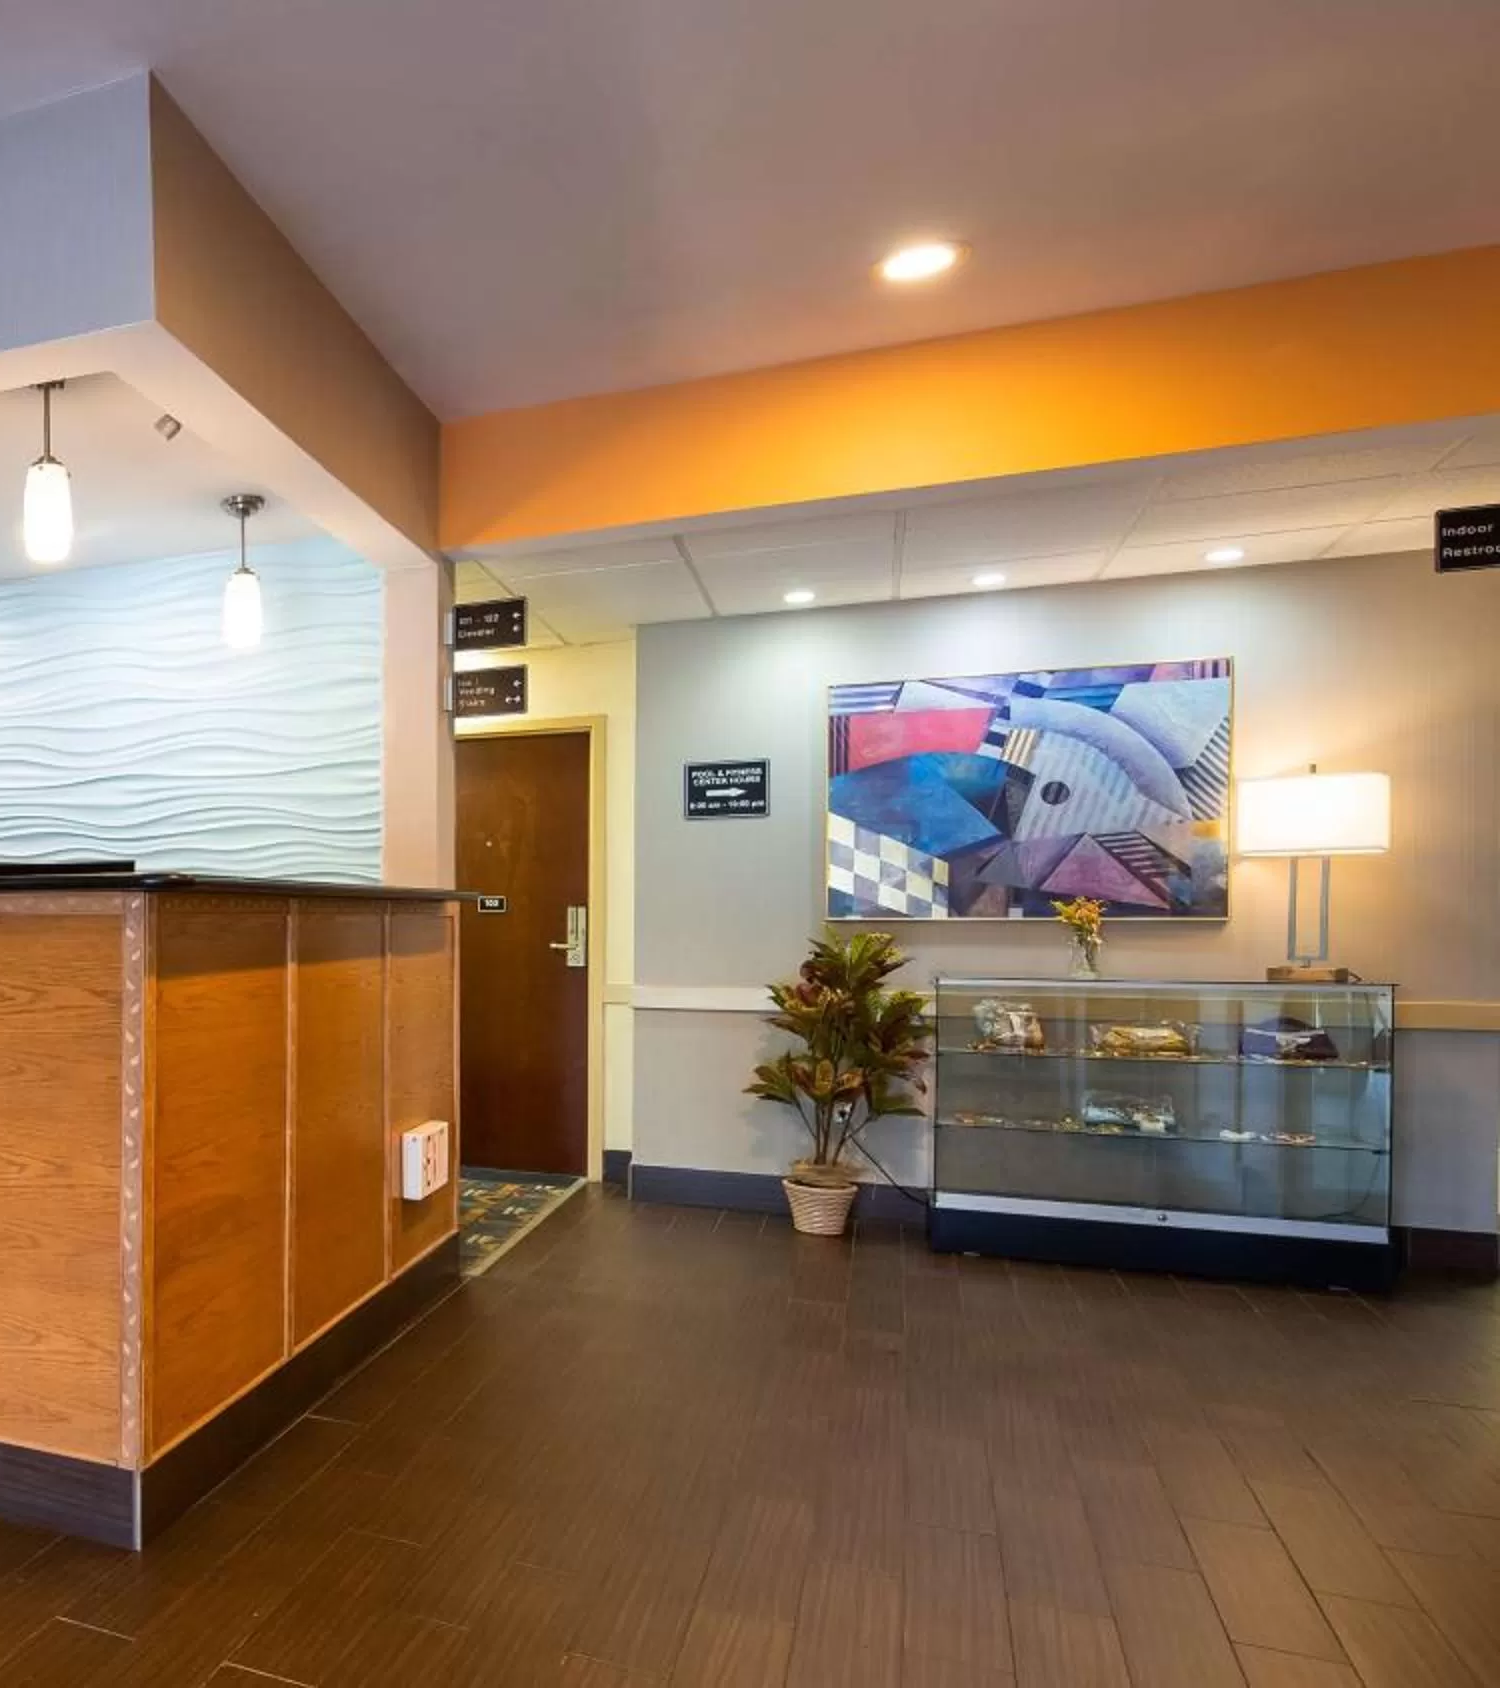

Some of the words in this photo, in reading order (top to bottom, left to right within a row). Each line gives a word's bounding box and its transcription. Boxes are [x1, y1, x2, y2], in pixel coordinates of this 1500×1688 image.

[1442, 524, 1493, 536] Indoor
[717, 769, 724, 777] &
[693, 777, 728, 786] CENTER
